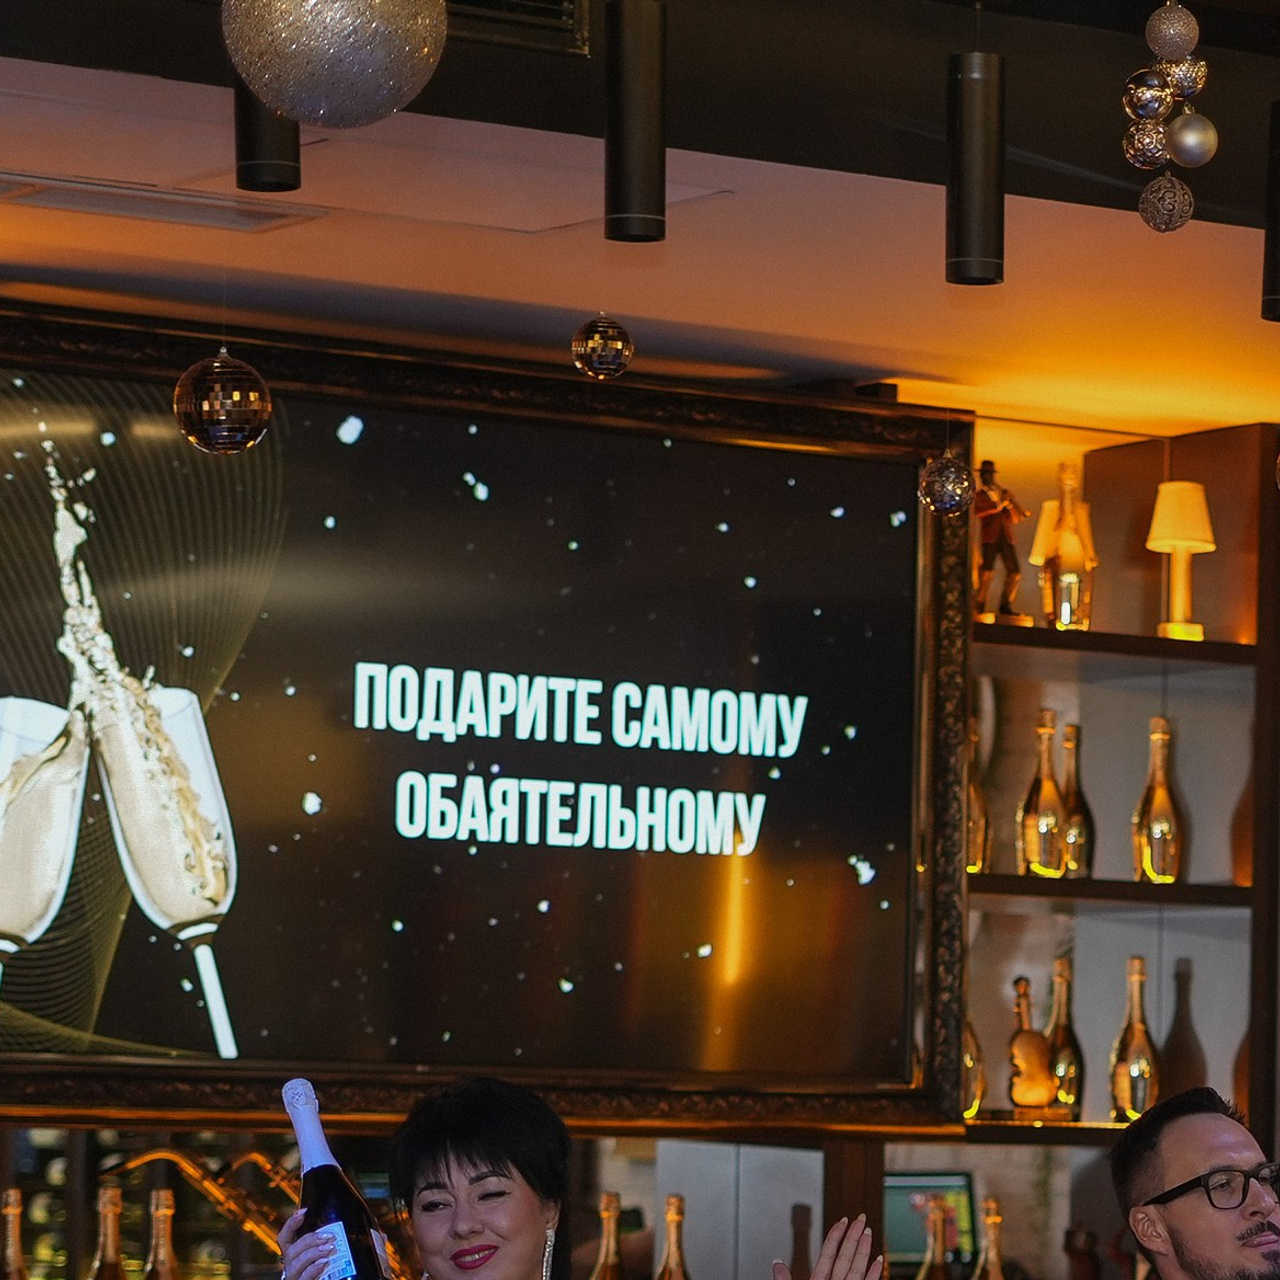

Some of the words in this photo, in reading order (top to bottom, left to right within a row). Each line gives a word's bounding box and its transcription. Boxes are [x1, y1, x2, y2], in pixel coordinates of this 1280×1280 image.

[354, 661, 603, 745] ПОДАРИТЕ
[612, 681, 809, 759] САМОМУ
[395, 770, 766, 857] ОБАЯТЕЛЬНОМУ
